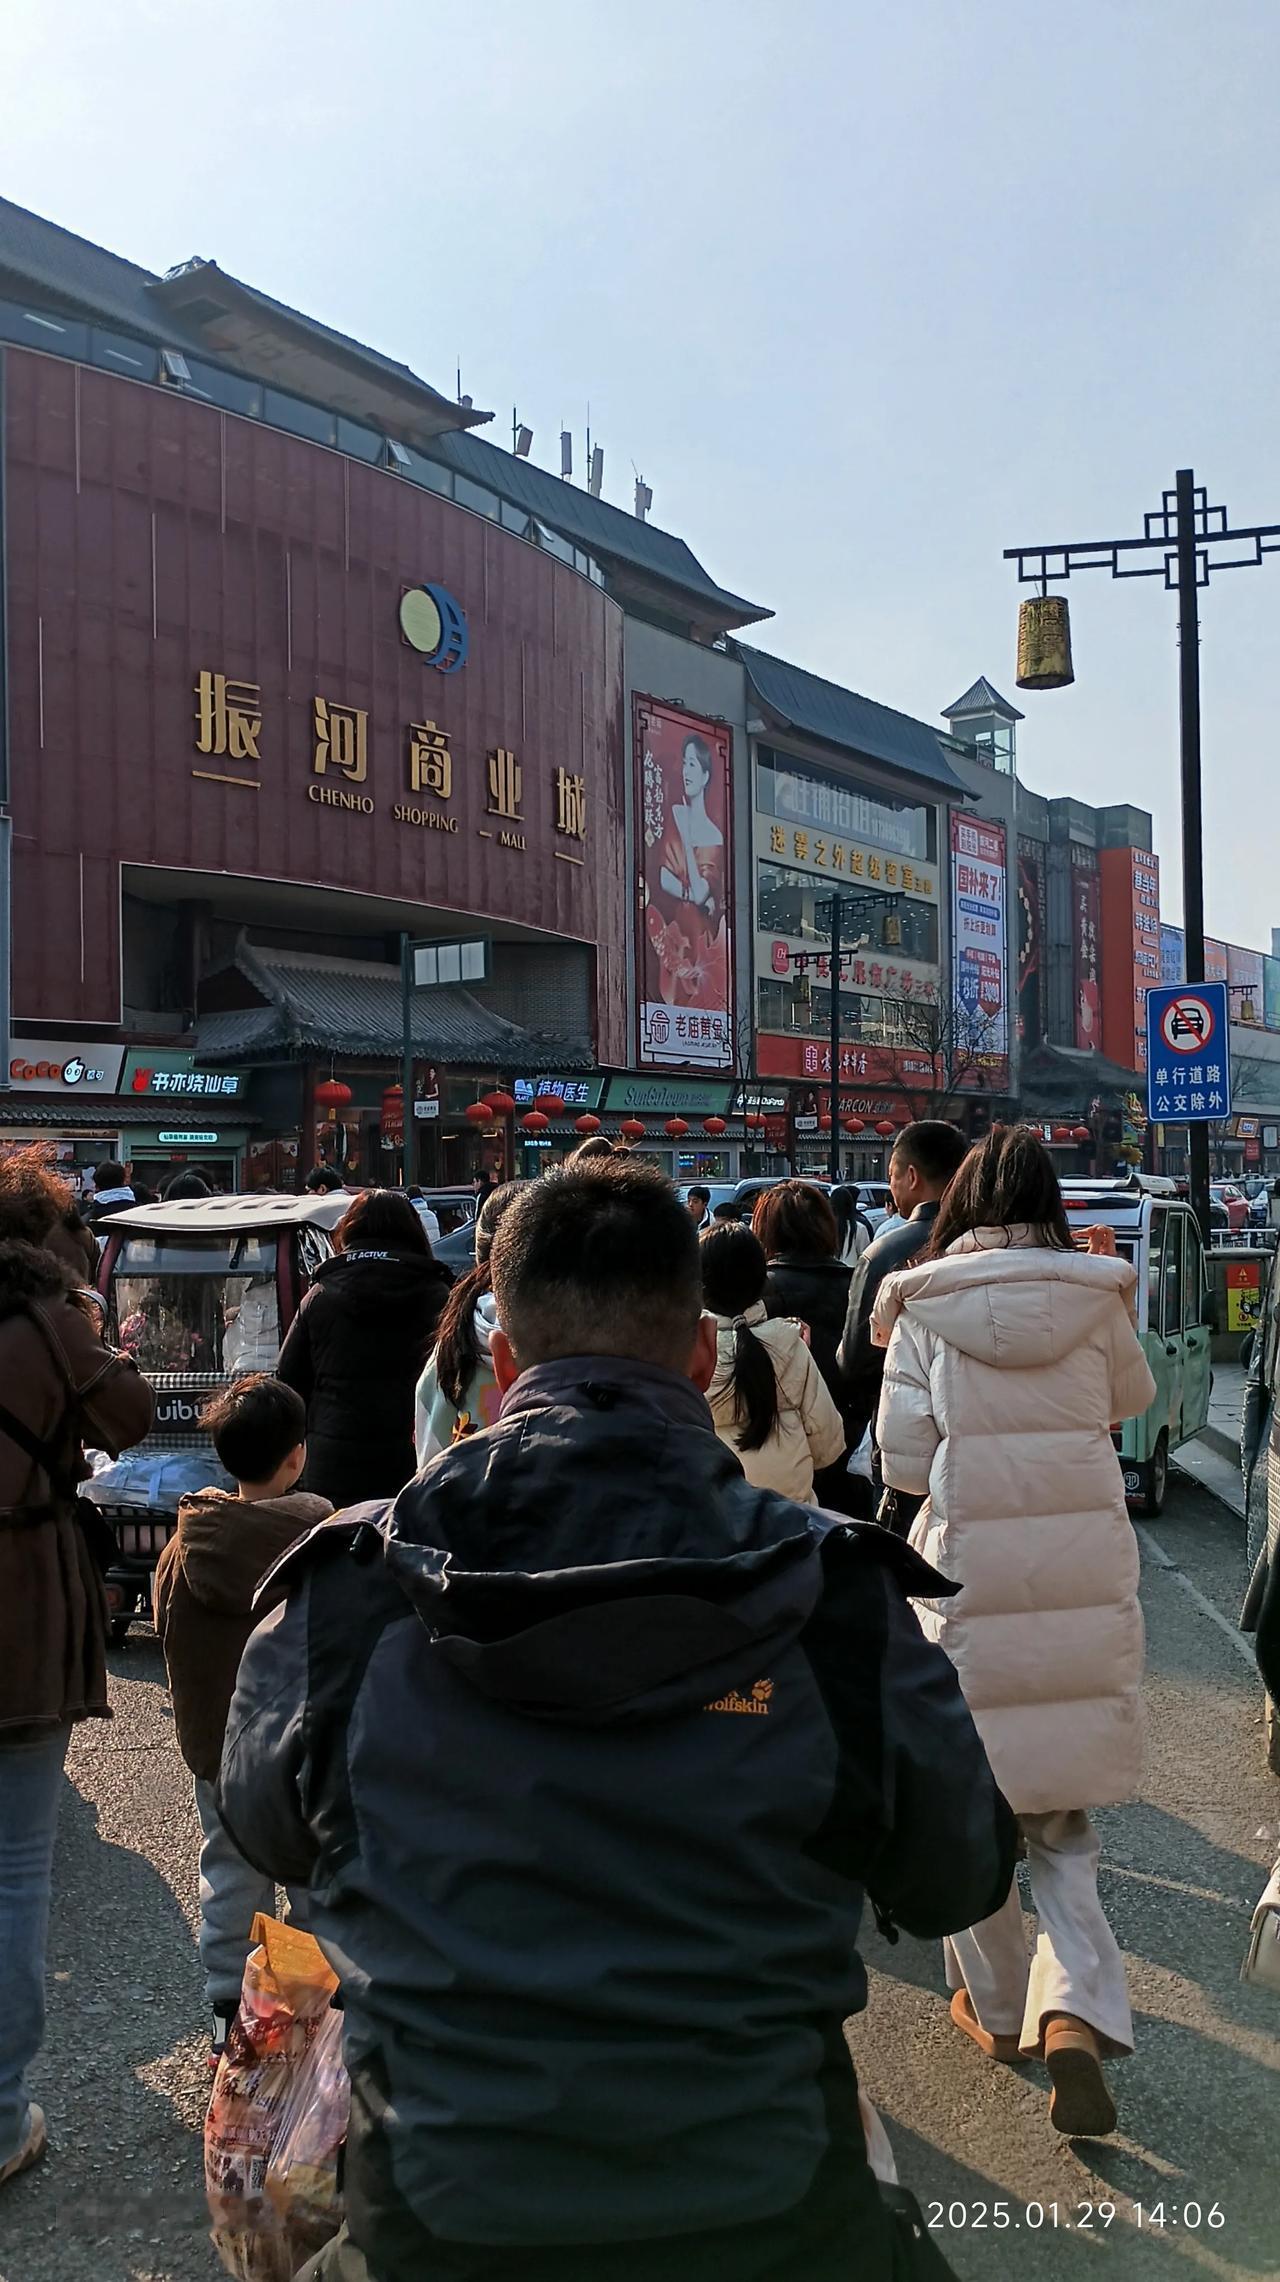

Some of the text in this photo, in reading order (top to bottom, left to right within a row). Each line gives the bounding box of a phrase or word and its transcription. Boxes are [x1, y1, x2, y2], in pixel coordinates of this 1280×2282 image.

[194, 670, 586, 841] 振河商业城
[308, 784, 527, 850] CHENHO SHOPPING MALL
[152, 1072, 239, 1094] 书亦烧仙草
[1155, 1065, 1221, 1086] 单行道路
[537, 1079, 590, 1102] 植物医生
[1156, 1091, 1223, 1112] 公交除外
[358, 1251, 389, 1259] ACTIVE
